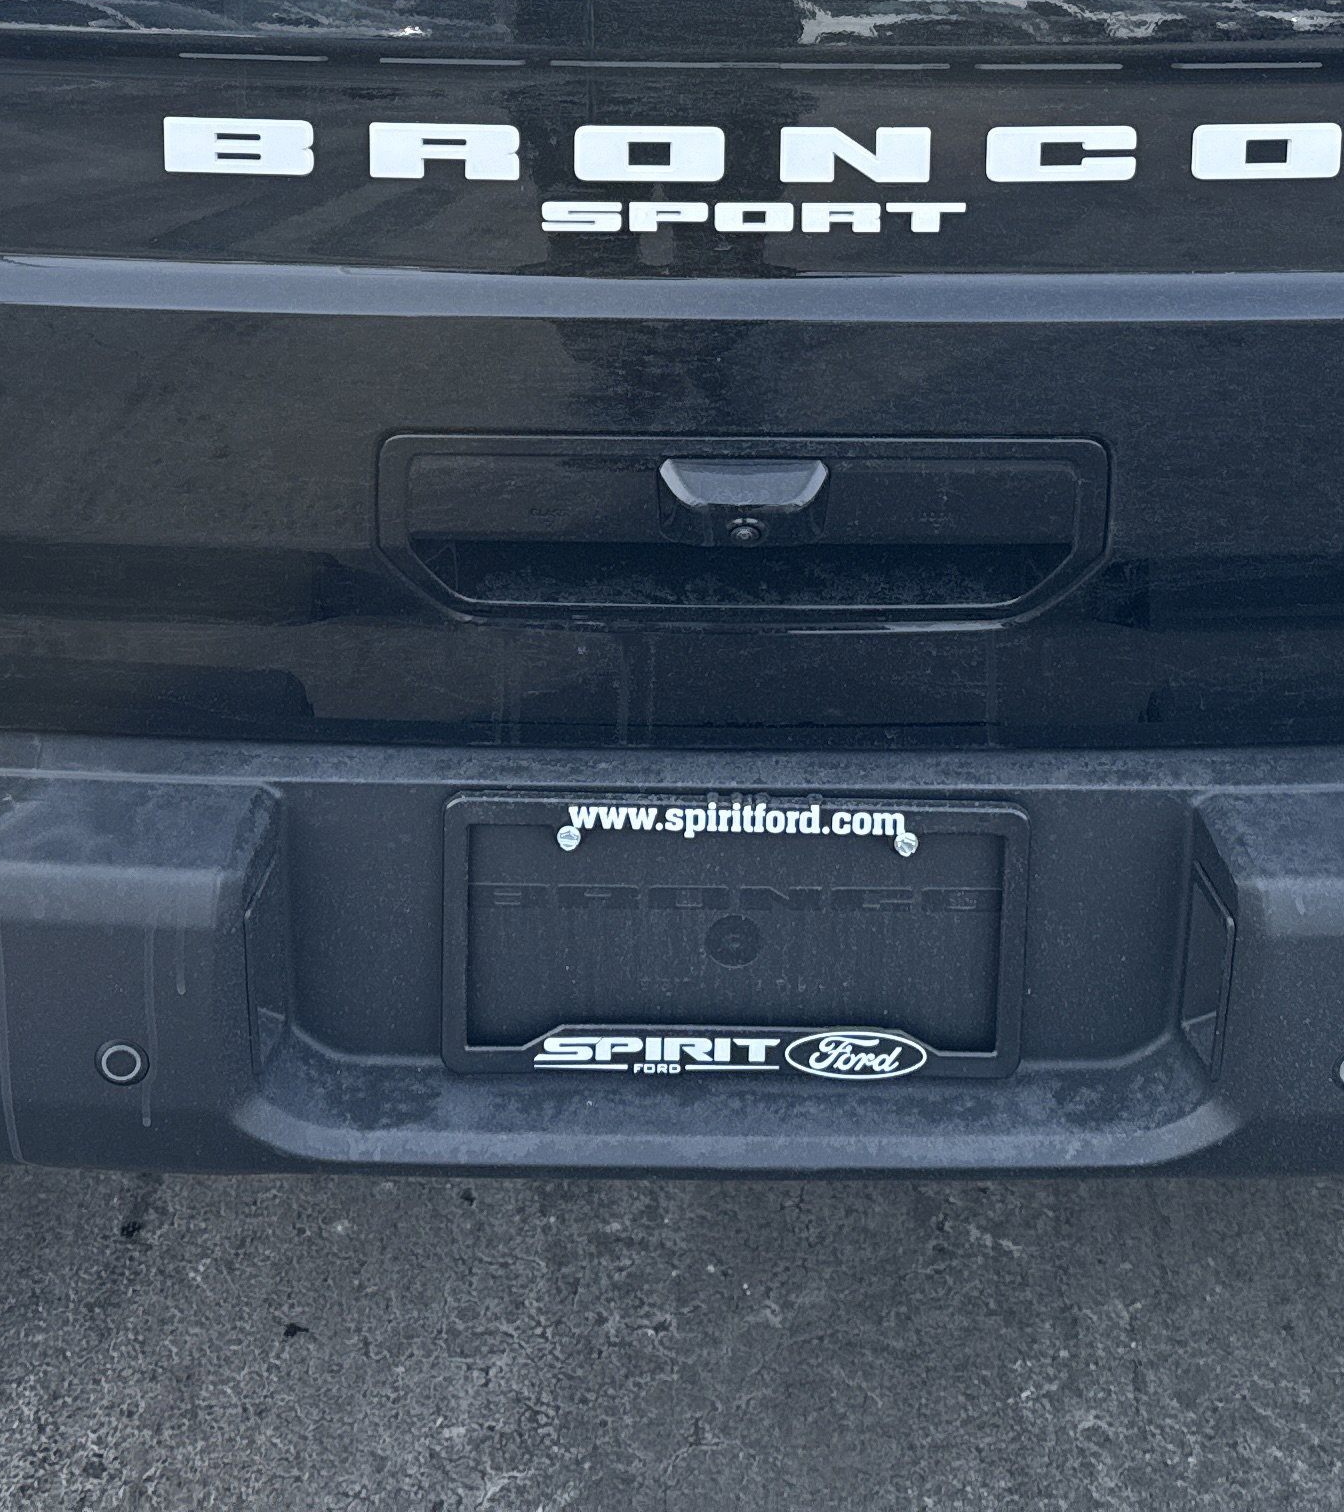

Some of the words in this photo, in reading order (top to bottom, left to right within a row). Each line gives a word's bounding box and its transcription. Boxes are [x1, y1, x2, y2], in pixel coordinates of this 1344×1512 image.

[163, 115, 1343, 184] BRONCO
[540, 200, 968, 234] SPORT
[569, 804, 906, 838] www.spiritford.com
[533, 1036, 781, 1064] SPIRIT
[807, 1033, 903, 1074] Ford
[632, 1063, 682, 1075] FORD
